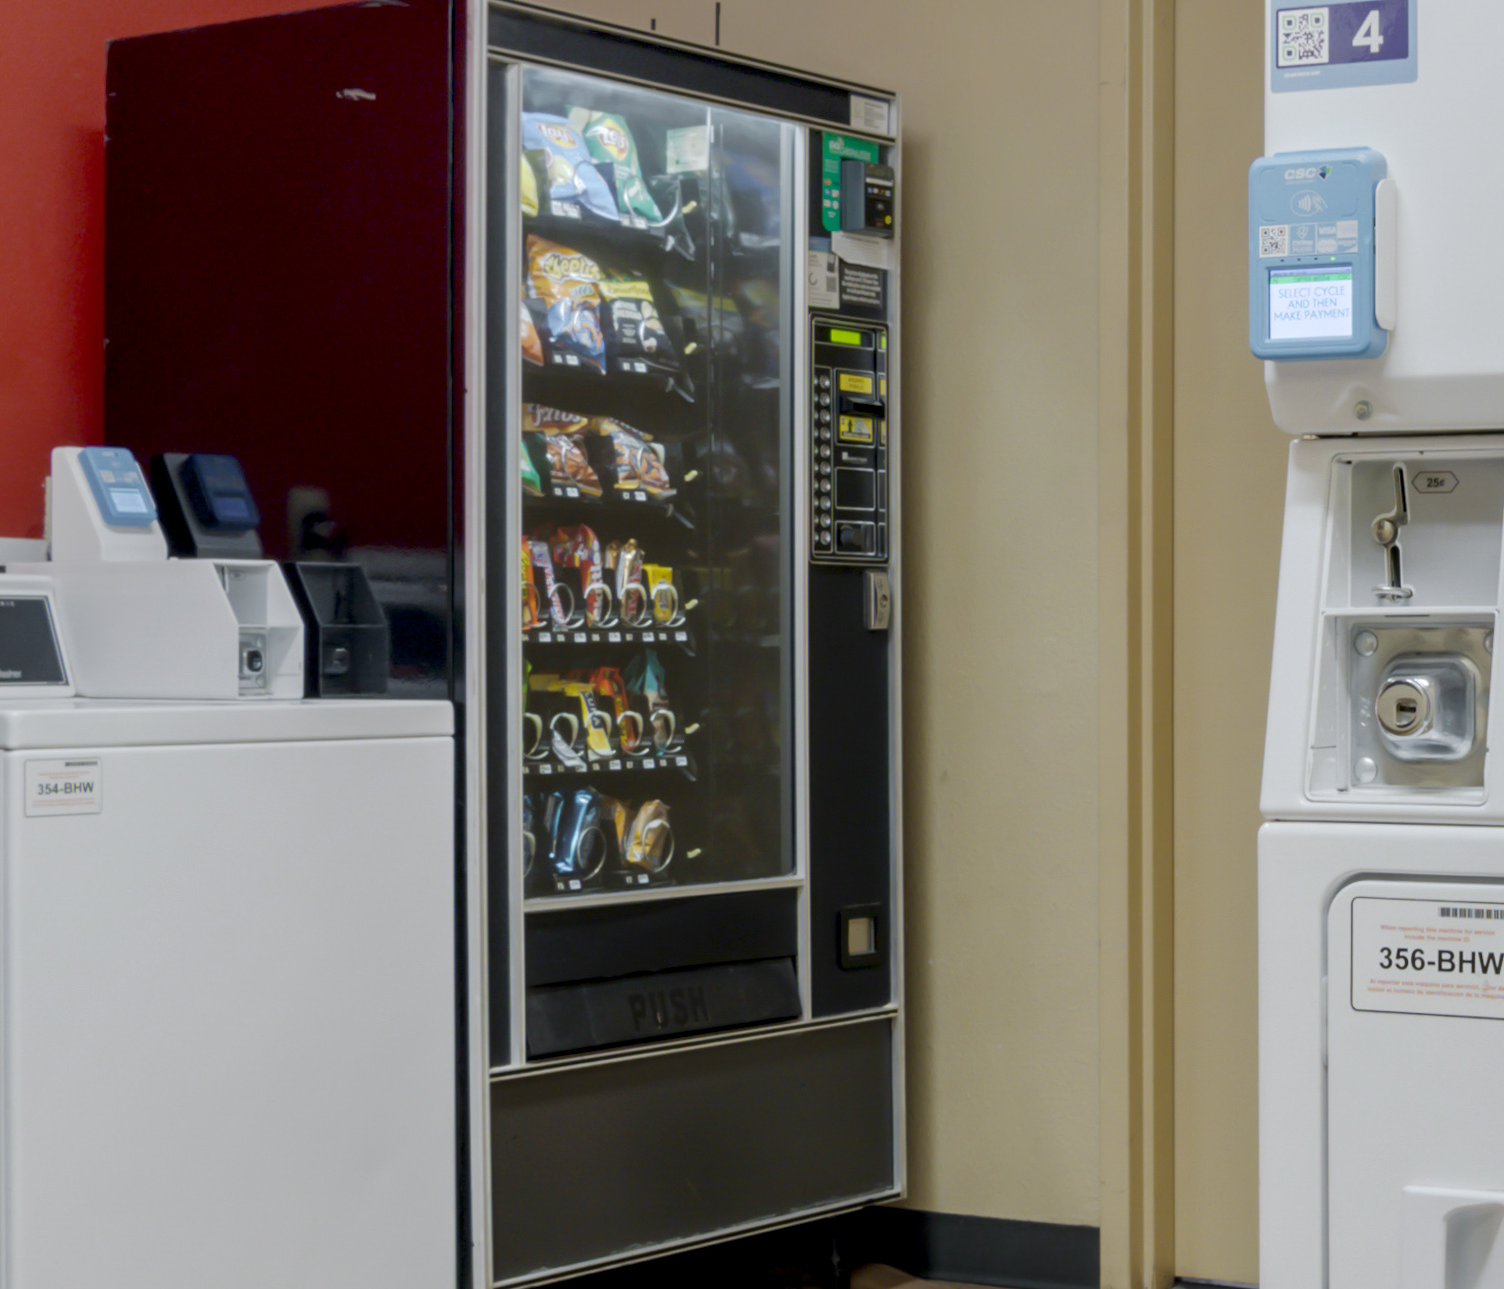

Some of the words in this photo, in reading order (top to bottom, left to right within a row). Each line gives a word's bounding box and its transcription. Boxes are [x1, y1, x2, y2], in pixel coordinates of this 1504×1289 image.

[1352, 10, 1384, 53] 4
[1284, 167, 1316, 180] CSC
[1278, 286, 1311, 299] SELECT
[1314, 286, 1345, 296] CYCLE
[1288, 299, 1309, 309] AND
[1313, 298, 1337, 307] THEN
[1274, 311, 1301, 321] MAKE
[1304, 308, 1350, 320] PAYMENT
[1427, 478, 1445, 488] 25¢
[38, 782, 94, 795] 354-BHW
[1379, 947, 1504, 975] 356-BHW
[628, 986, 709, 1032] PUSH
